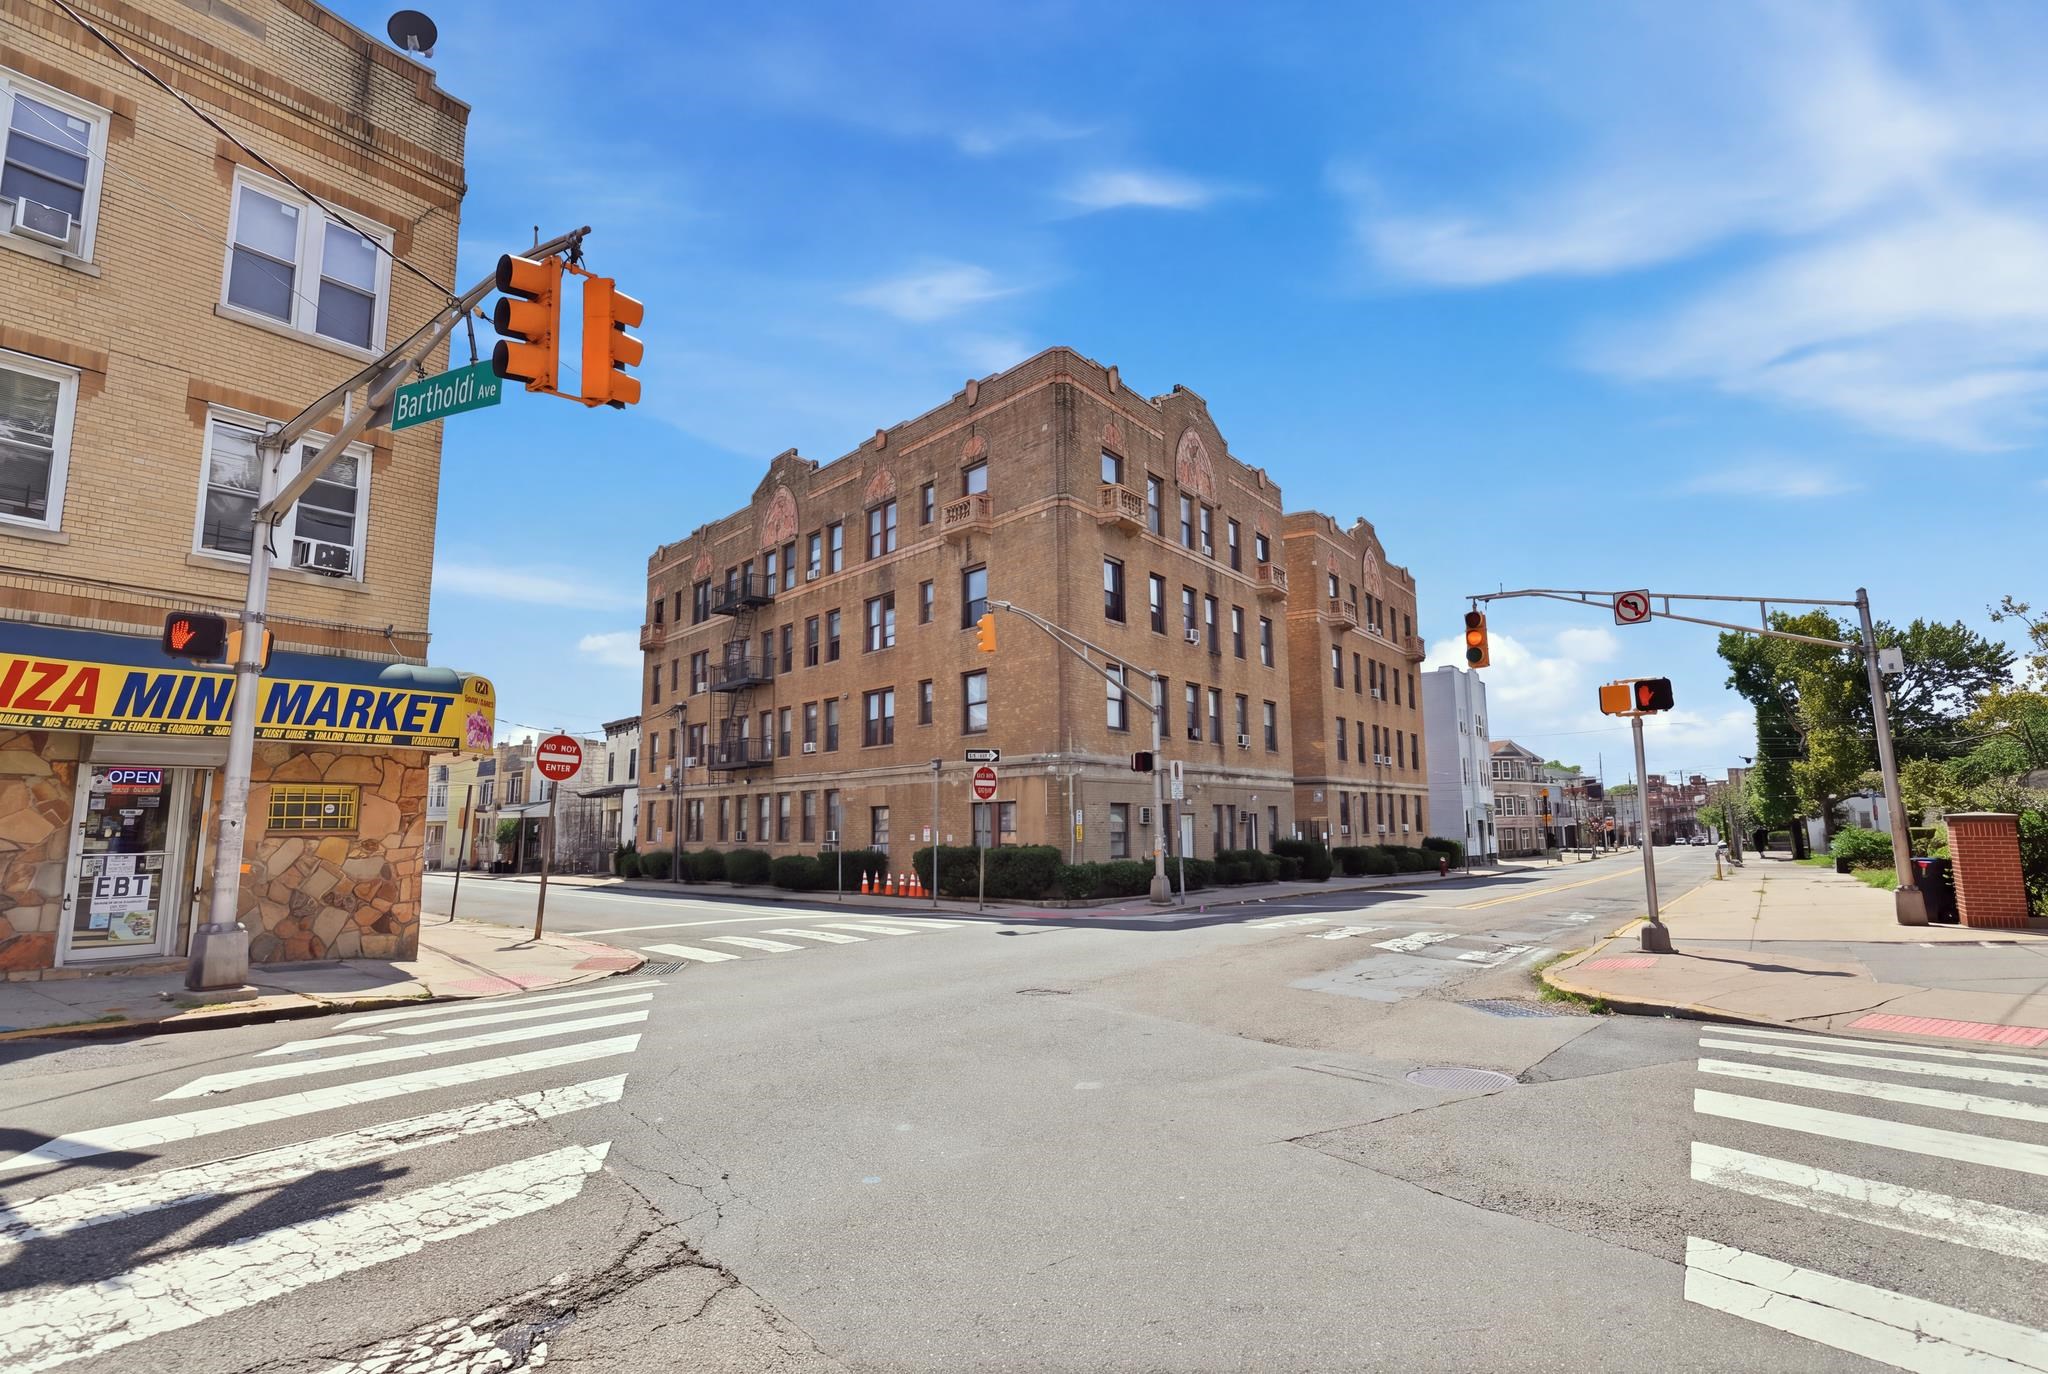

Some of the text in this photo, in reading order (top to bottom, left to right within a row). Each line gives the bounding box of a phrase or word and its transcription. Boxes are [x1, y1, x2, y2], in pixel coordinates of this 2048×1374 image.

[397, 373, 497, 421] Bartholdi Ave
[111, 671, 234, 722] MIN
[260, 682, 454, 734] MARKET
[109, 770, 161, 784] OPEN
[545, 763, 571, 773] ENTER
[95, 876, 149, 897] EBT
